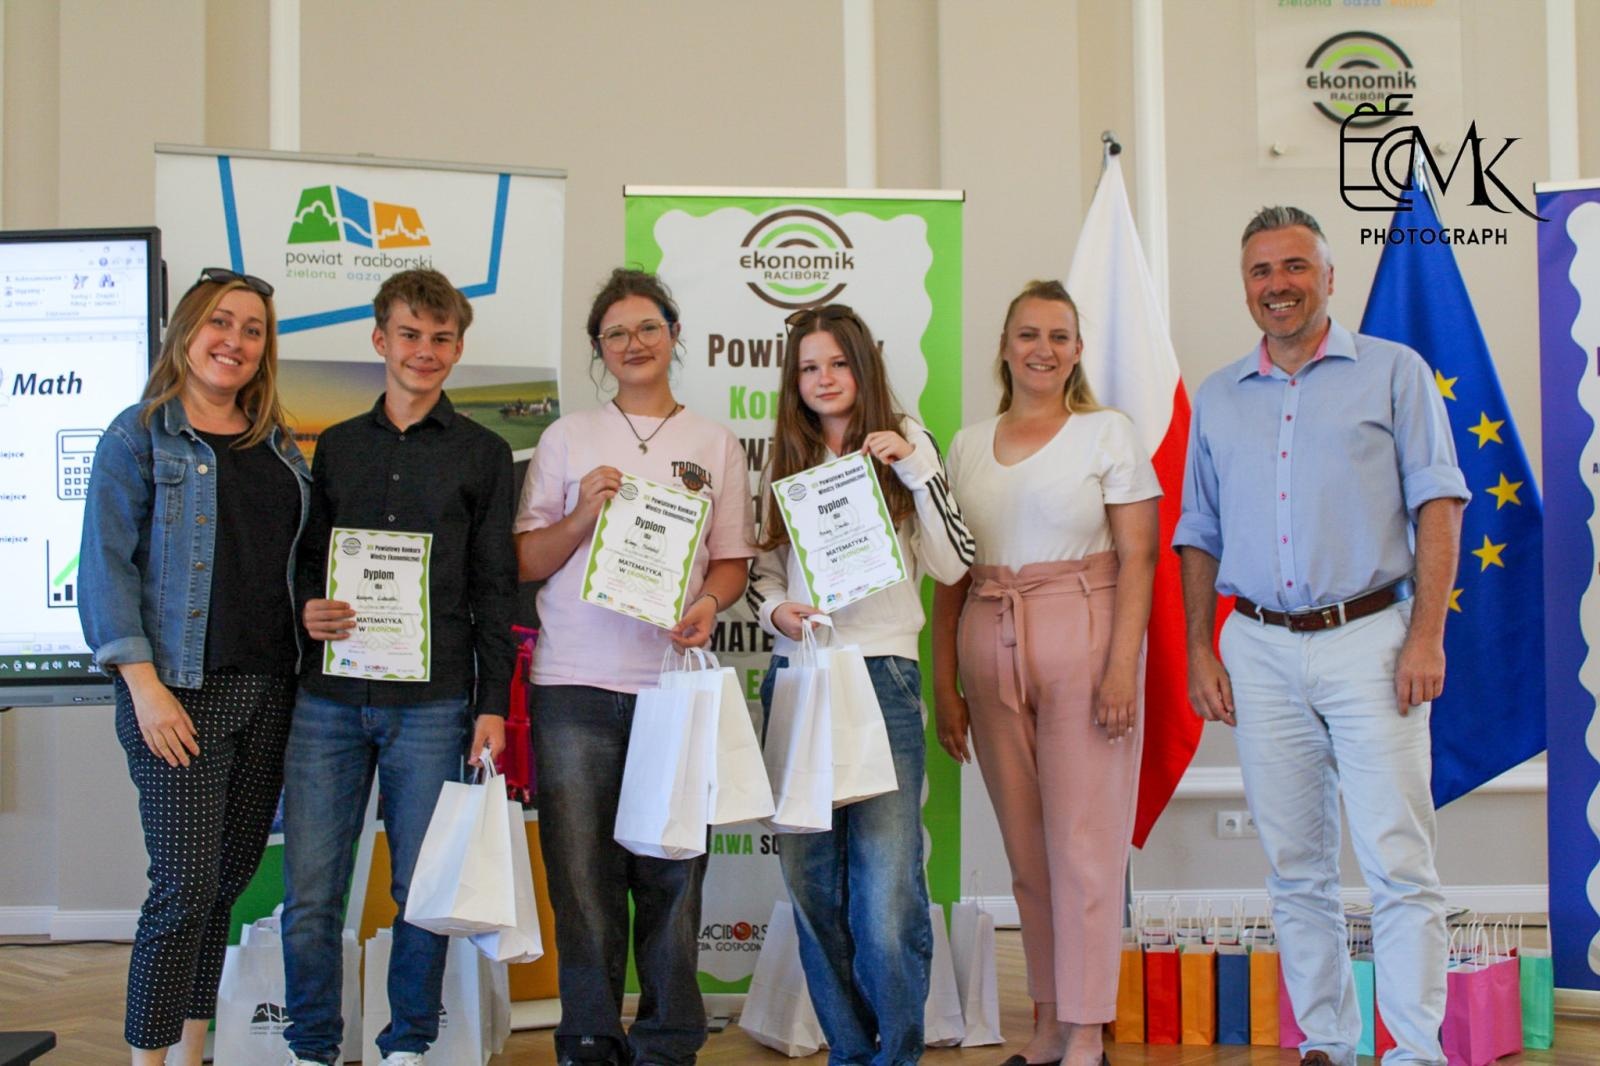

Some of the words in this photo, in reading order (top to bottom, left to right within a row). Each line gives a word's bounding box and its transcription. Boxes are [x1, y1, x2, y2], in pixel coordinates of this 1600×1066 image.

[1306, 71, 1417, 89] ekonomik
[285, 250, 343, 266] powiat
[354, 252, 433, 269] raciborski
[739, 251, 855, 270] ekonomik
[286, 268, 336, 279] zielona
[346, 271, 382, 281] oaza
[12, 371, 83, 396] Math
[0, 450, 24, 460] iejsce
[817, 496, 849, 515] Dyplom
[635, 516, 666, 535] Dyplom
[826, 536, 869, 557] MATEMATYKA
[363, 568, 395, 581] Dyplom
[618, 558, 662, 577] MATEMATYKA
[698, 922, 768, 941] ACIBORS
